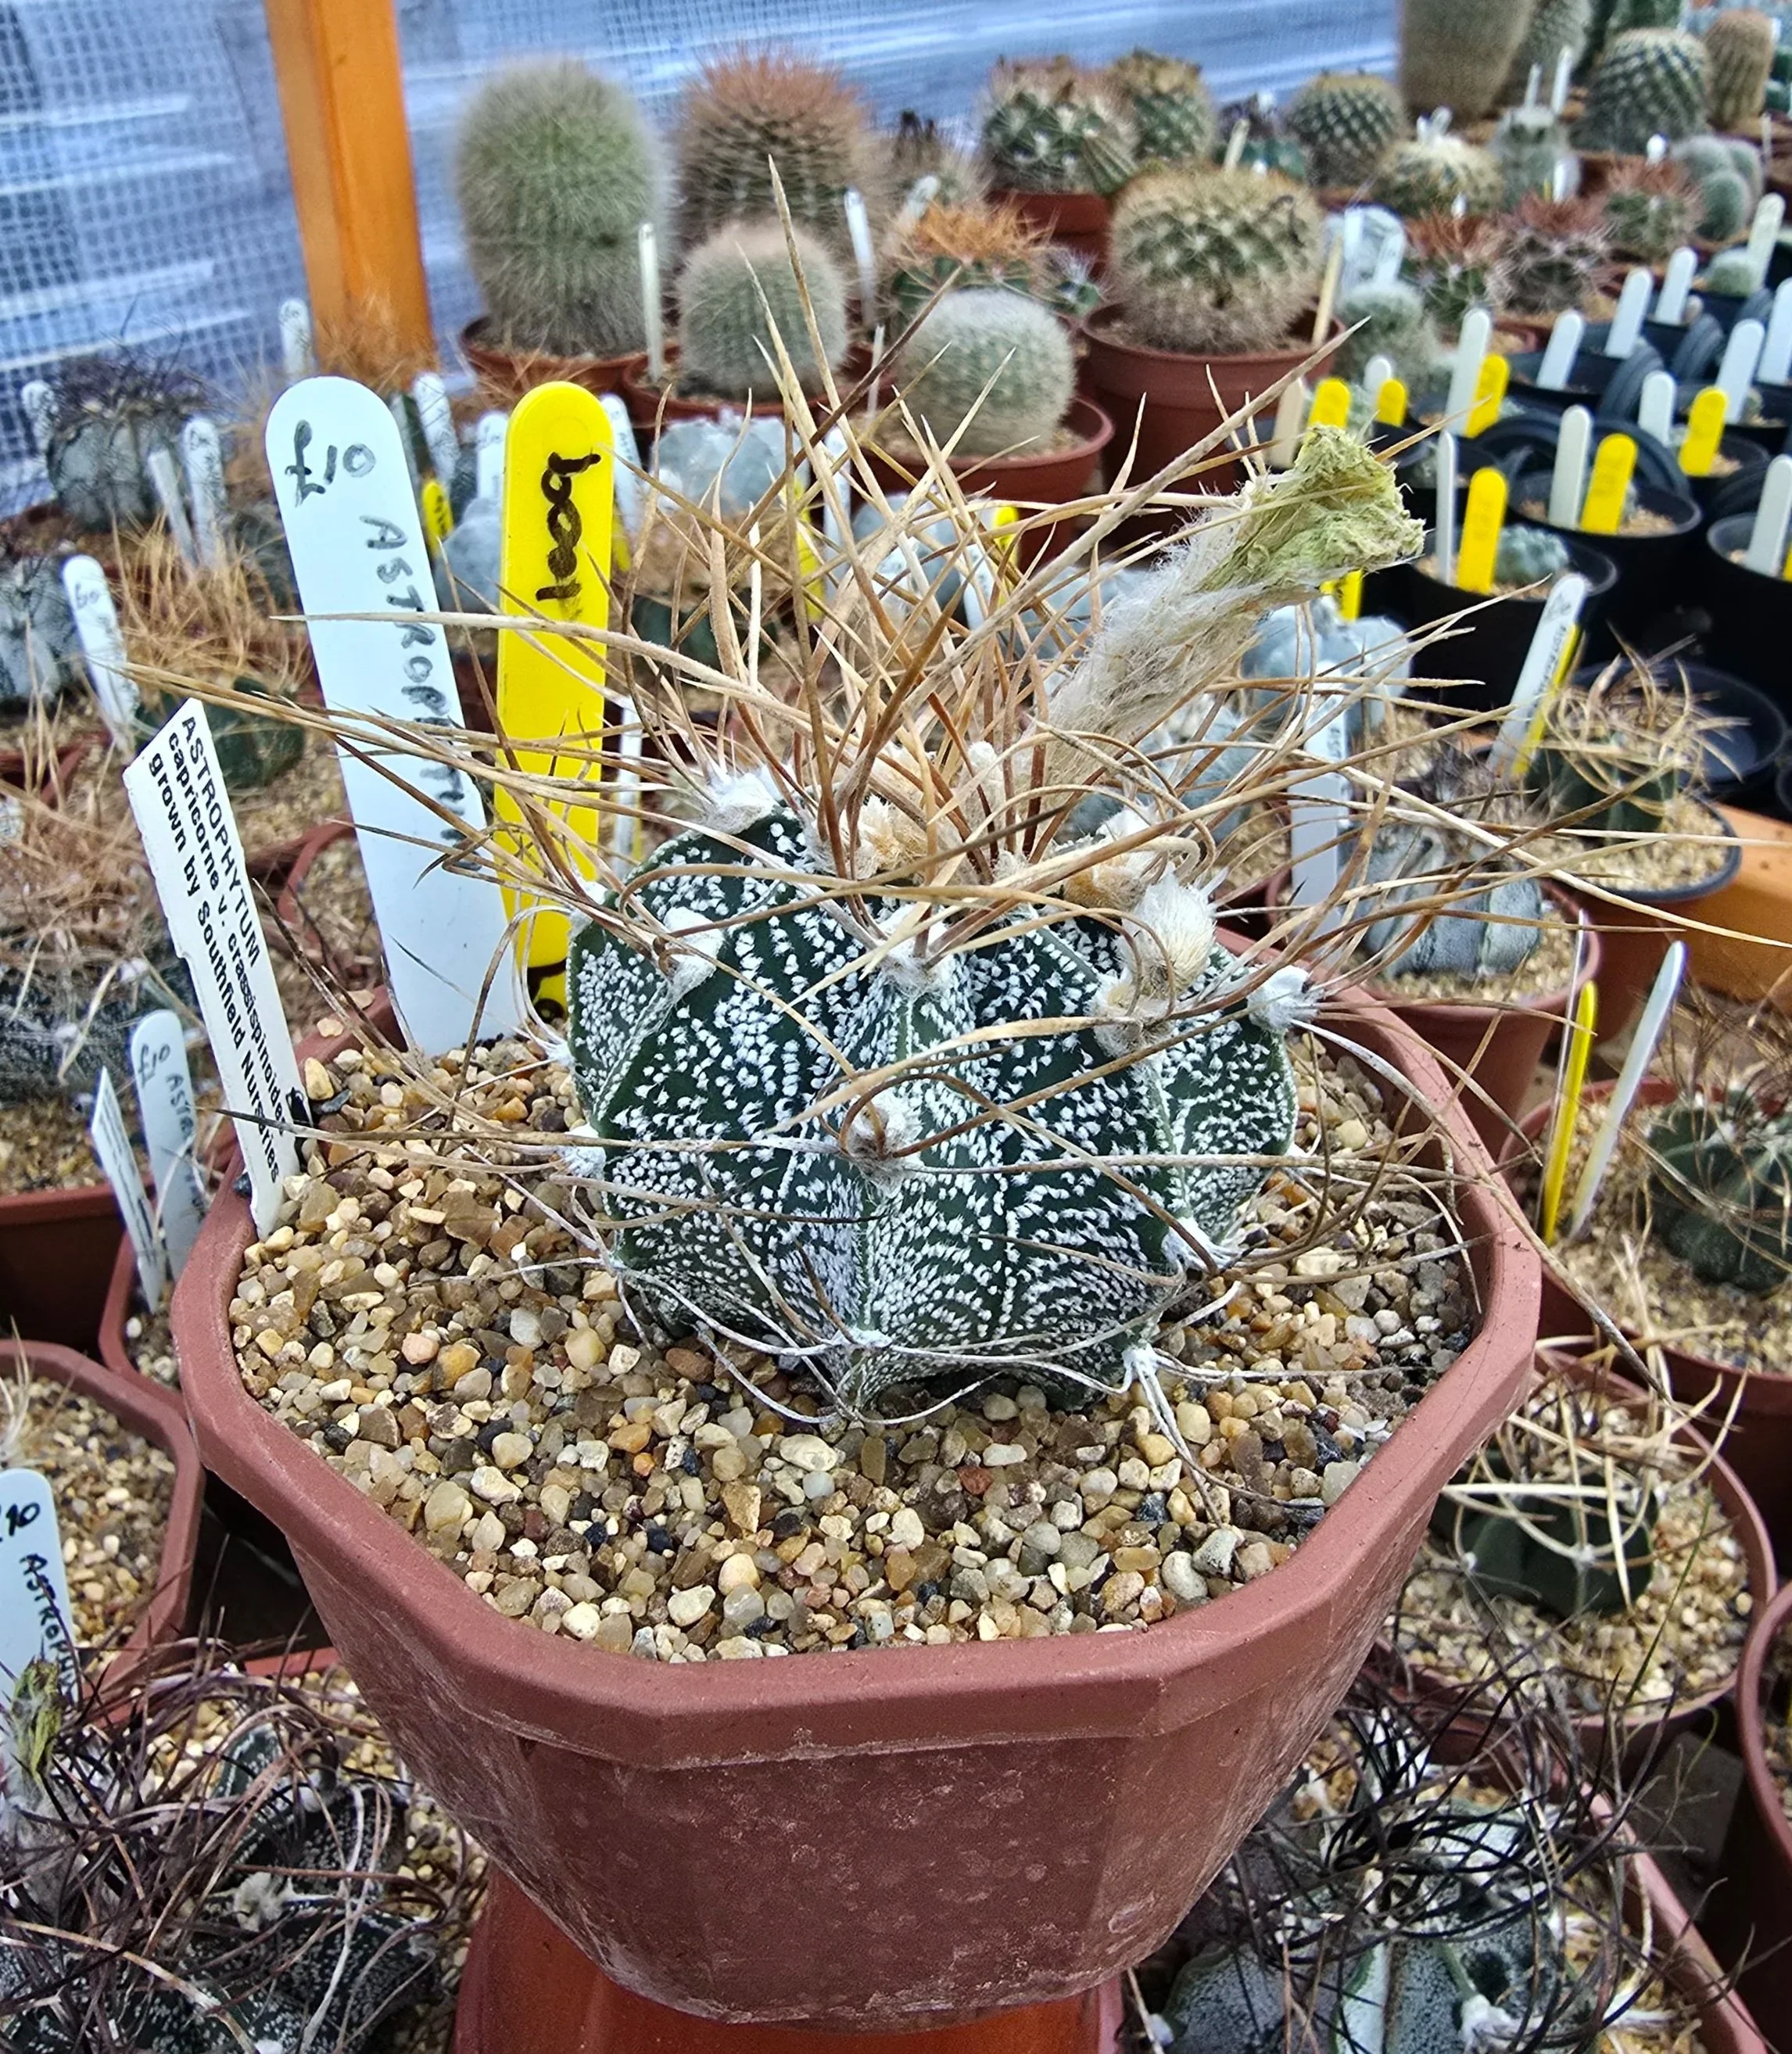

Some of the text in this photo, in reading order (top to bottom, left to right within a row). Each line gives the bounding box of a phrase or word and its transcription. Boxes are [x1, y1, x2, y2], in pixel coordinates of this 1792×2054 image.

[285, 419, 376, 508] £10
[169, 732, 220, 891] capricorne
[218, 894, 228, 927] v.
[182, 716, 260, 968] ASTROPHYTUM
[149, 753, 281, 1184] grown by Southfield Nurseries
[0, 1501, 41, 1543] 10
